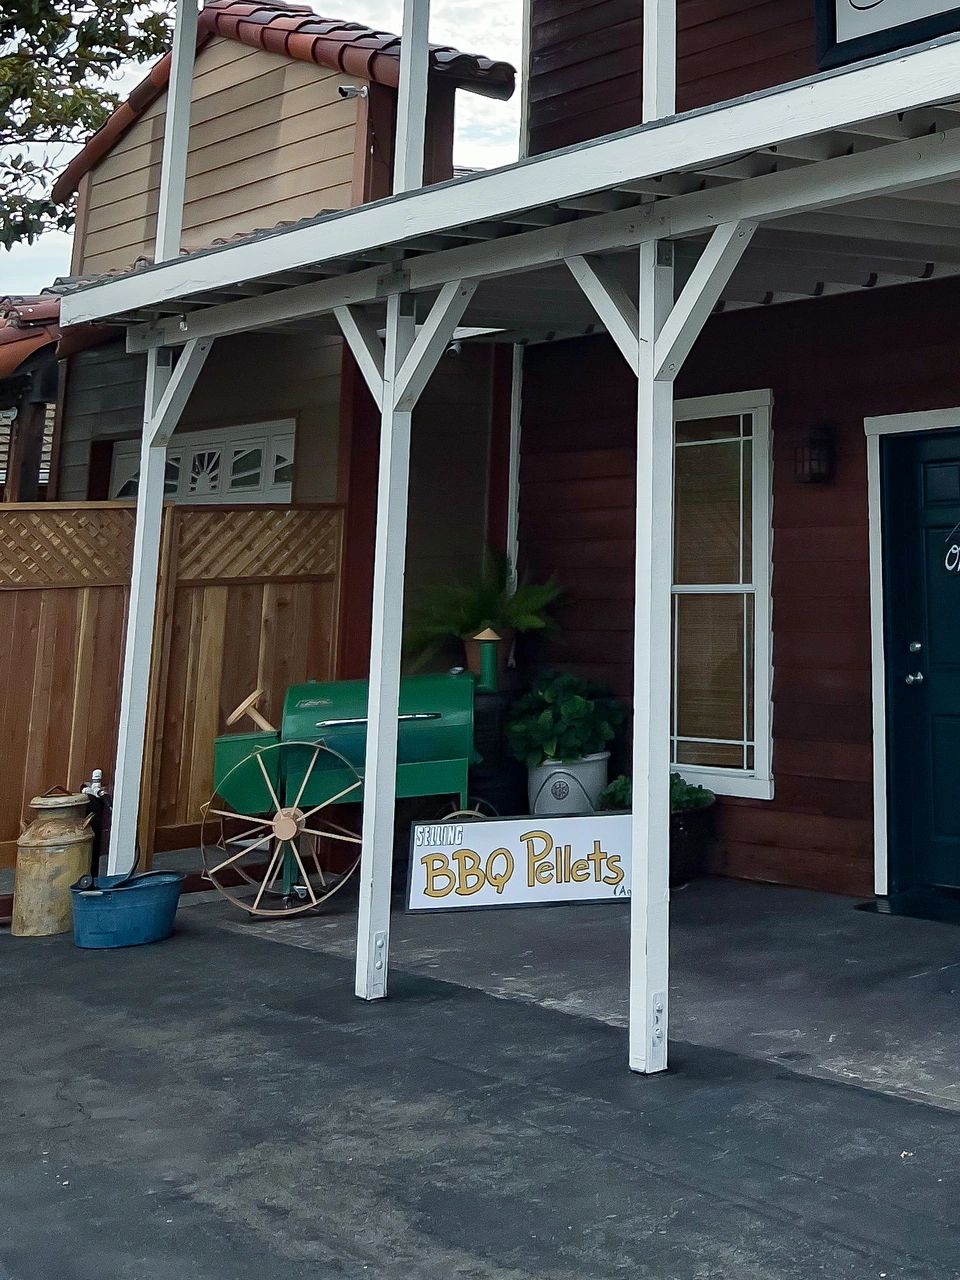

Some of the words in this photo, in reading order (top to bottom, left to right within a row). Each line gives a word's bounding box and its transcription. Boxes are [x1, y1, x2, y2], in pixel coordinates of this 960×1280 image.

[416, 825, 463, 847] SELLING
[421, 848, 514, 898] BBQ
[520, 830, 624, 887] Pellets
